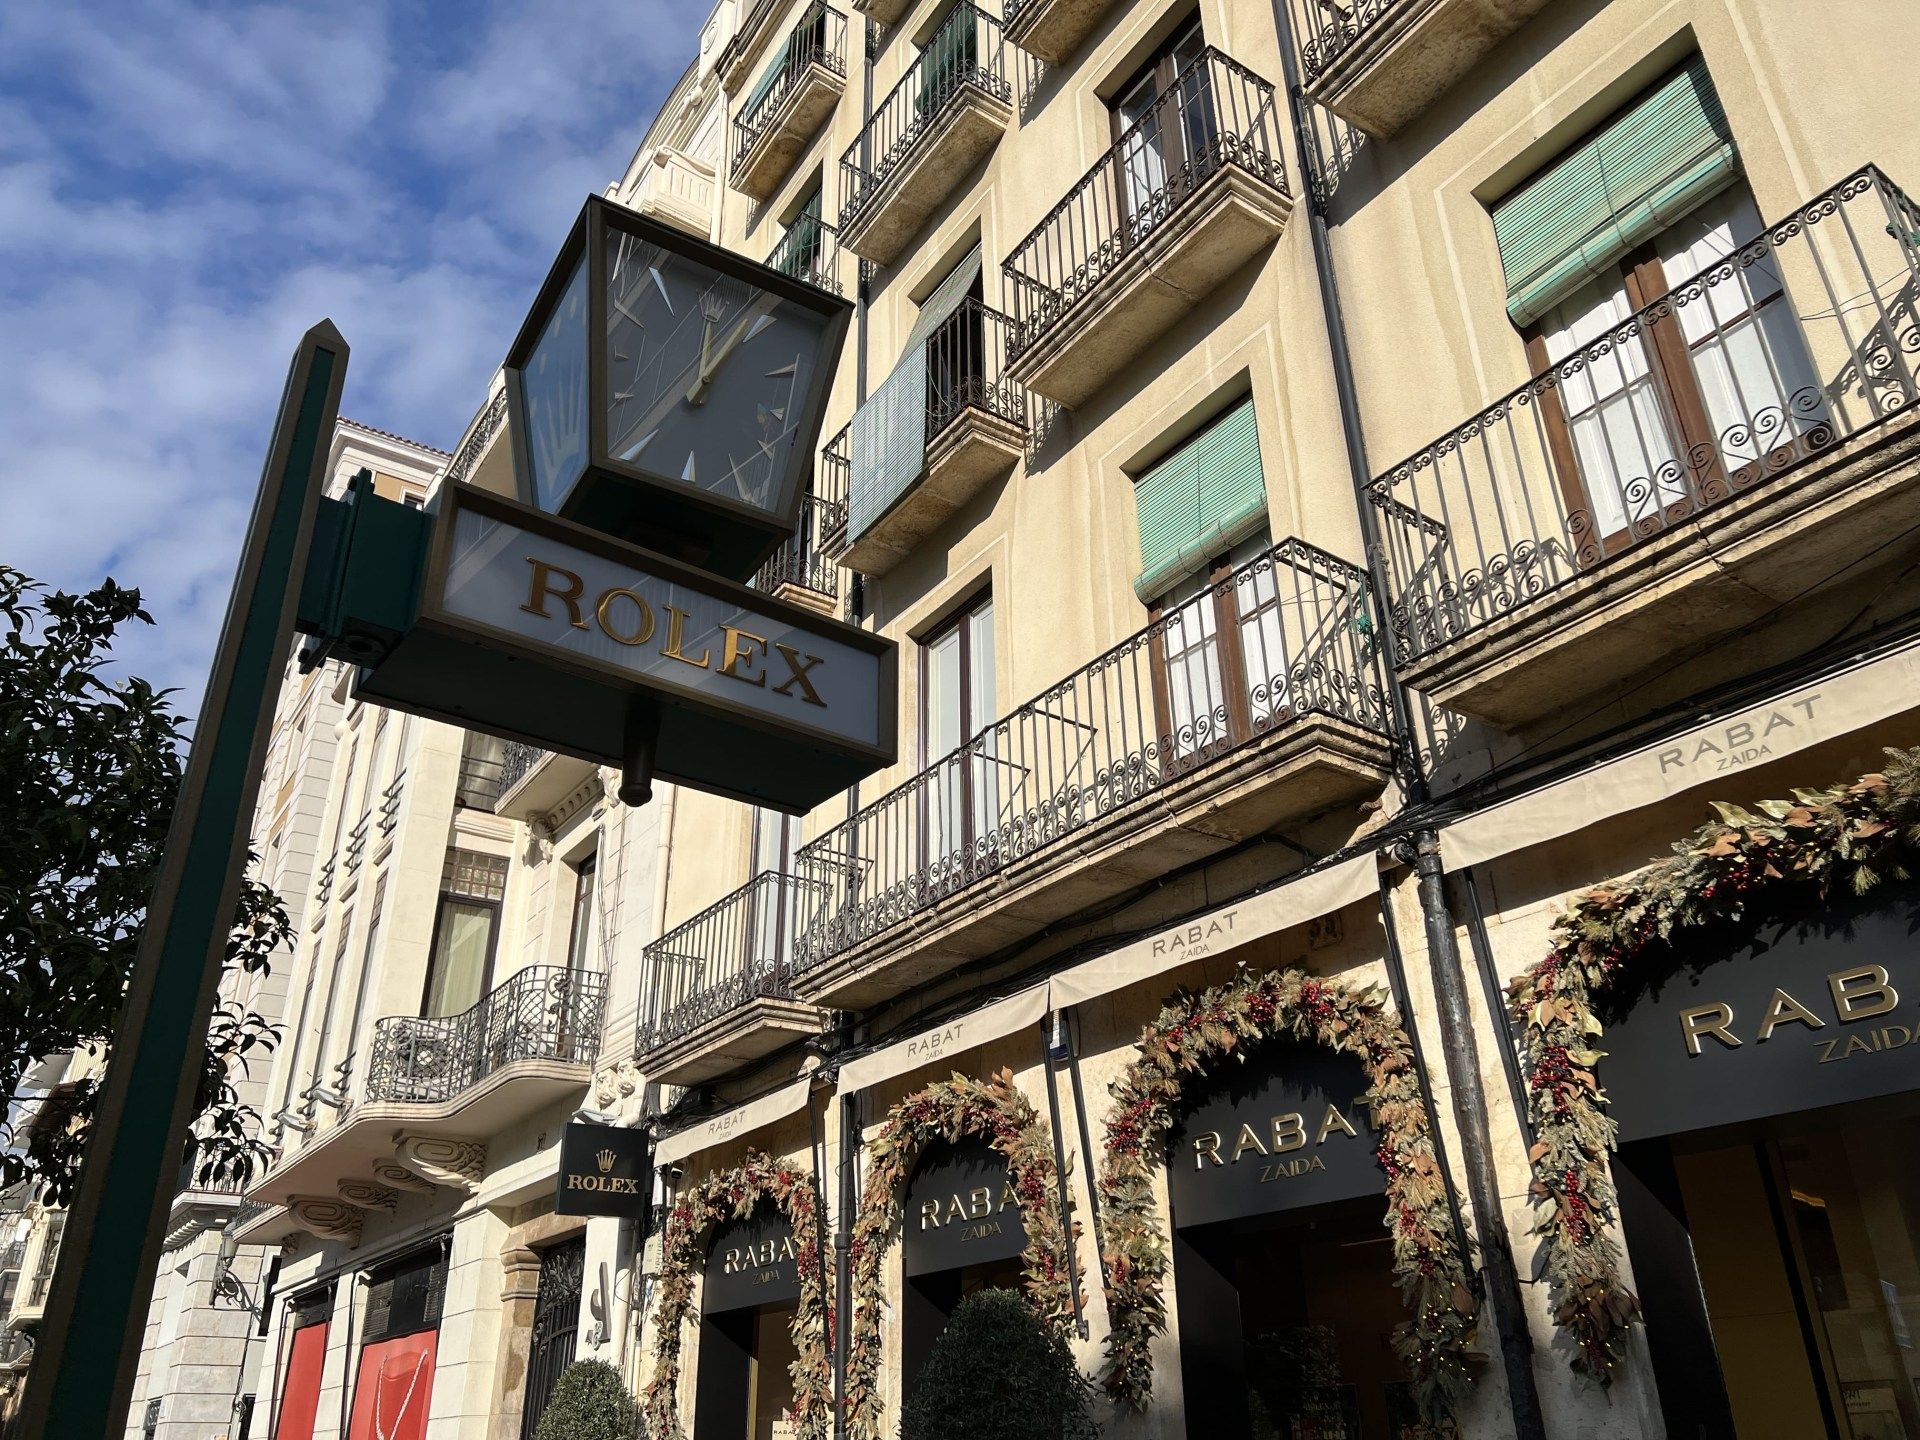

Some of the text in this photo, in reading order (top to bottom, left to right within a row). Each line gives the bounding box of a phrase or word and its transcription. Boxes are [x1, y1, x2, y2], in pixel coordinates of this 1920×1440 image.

[519, 555, 828, 709] ROLEX
[1658, 693, 1822, 774] RABAT
[1716, 744, 1772, 771] ZAIDA
[1152, 910, 1238, 958] RABAT
[1180, 943, 1210, 961] ZAIDA
[1679, 963, 1900, 1055] RAB
[907, 1023, 964, 1058] RABAT
[707, 1109, 746, 1135] RABAT
[567, 1174, 639, 1194] ROLEX
[1259, 1154, 1326, 1183] ZAIDA
[920, 1180, 1021, 1230] RABA
[960, 1221, 1002, 1242] ZAIDA
[723, 1236, 795, 1274] RABA
